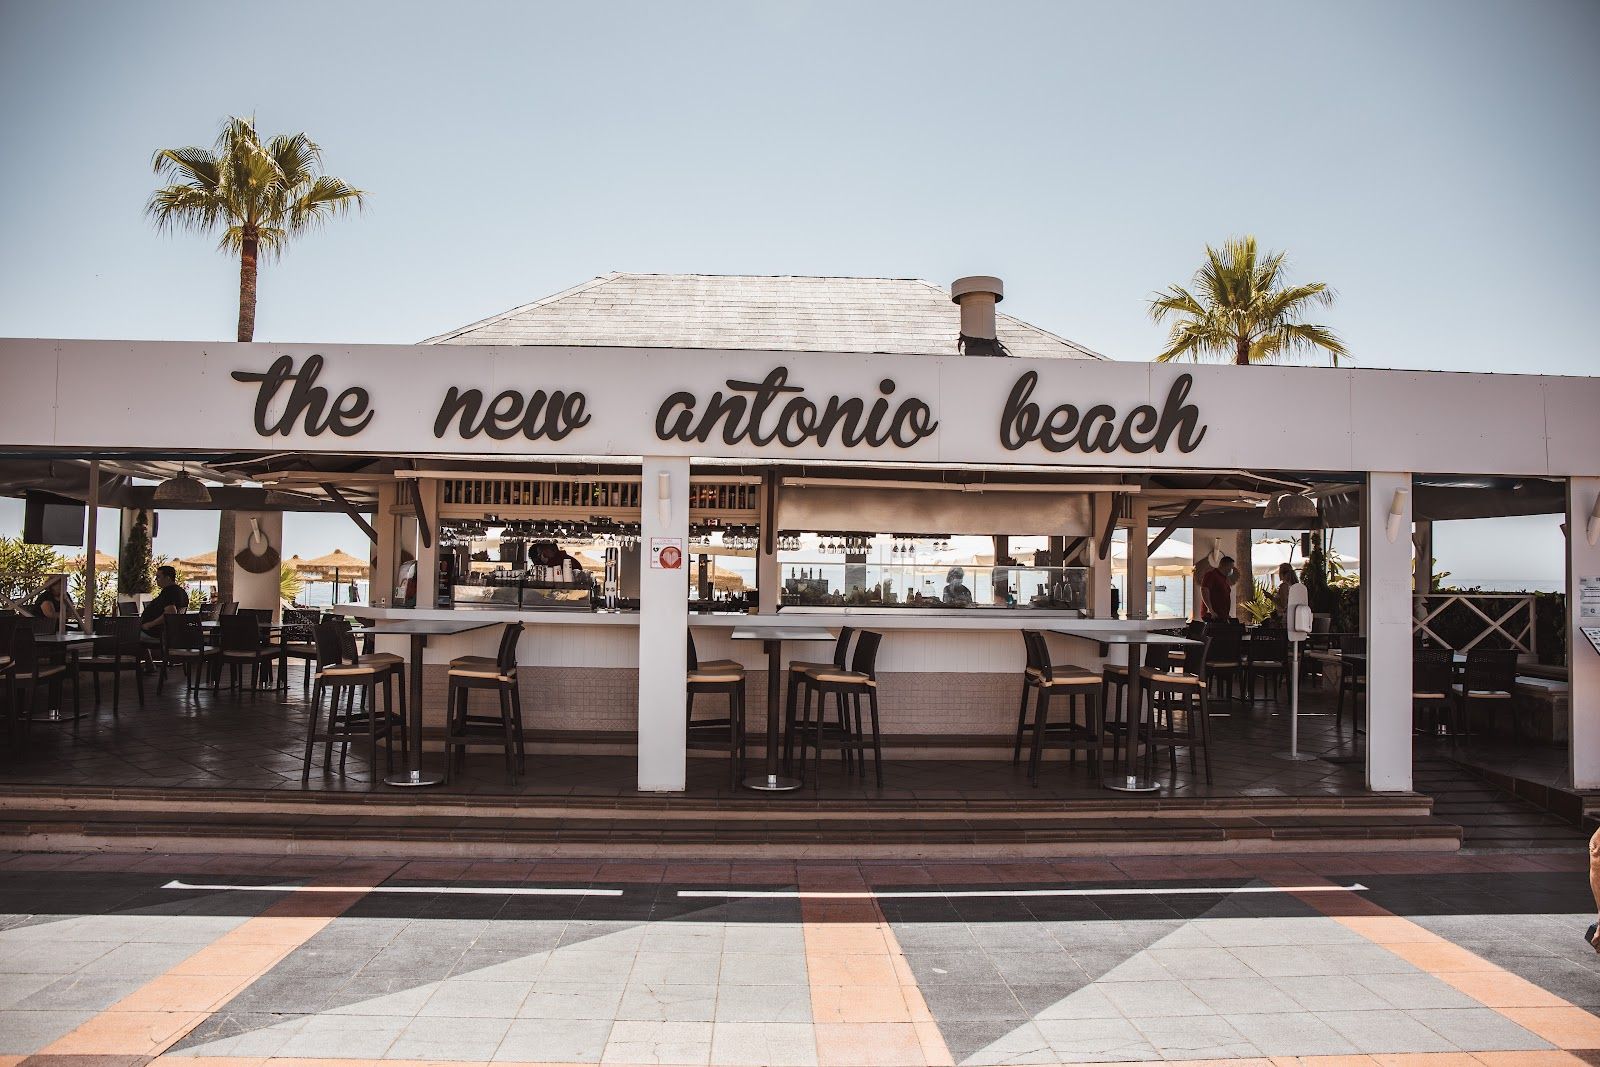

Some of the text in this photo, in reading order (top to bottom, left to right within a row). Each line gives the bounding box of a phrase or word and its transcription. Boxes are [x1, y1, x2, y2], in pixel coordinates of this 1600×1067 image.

[231, 354, 1208, 454] the new antonio beach
